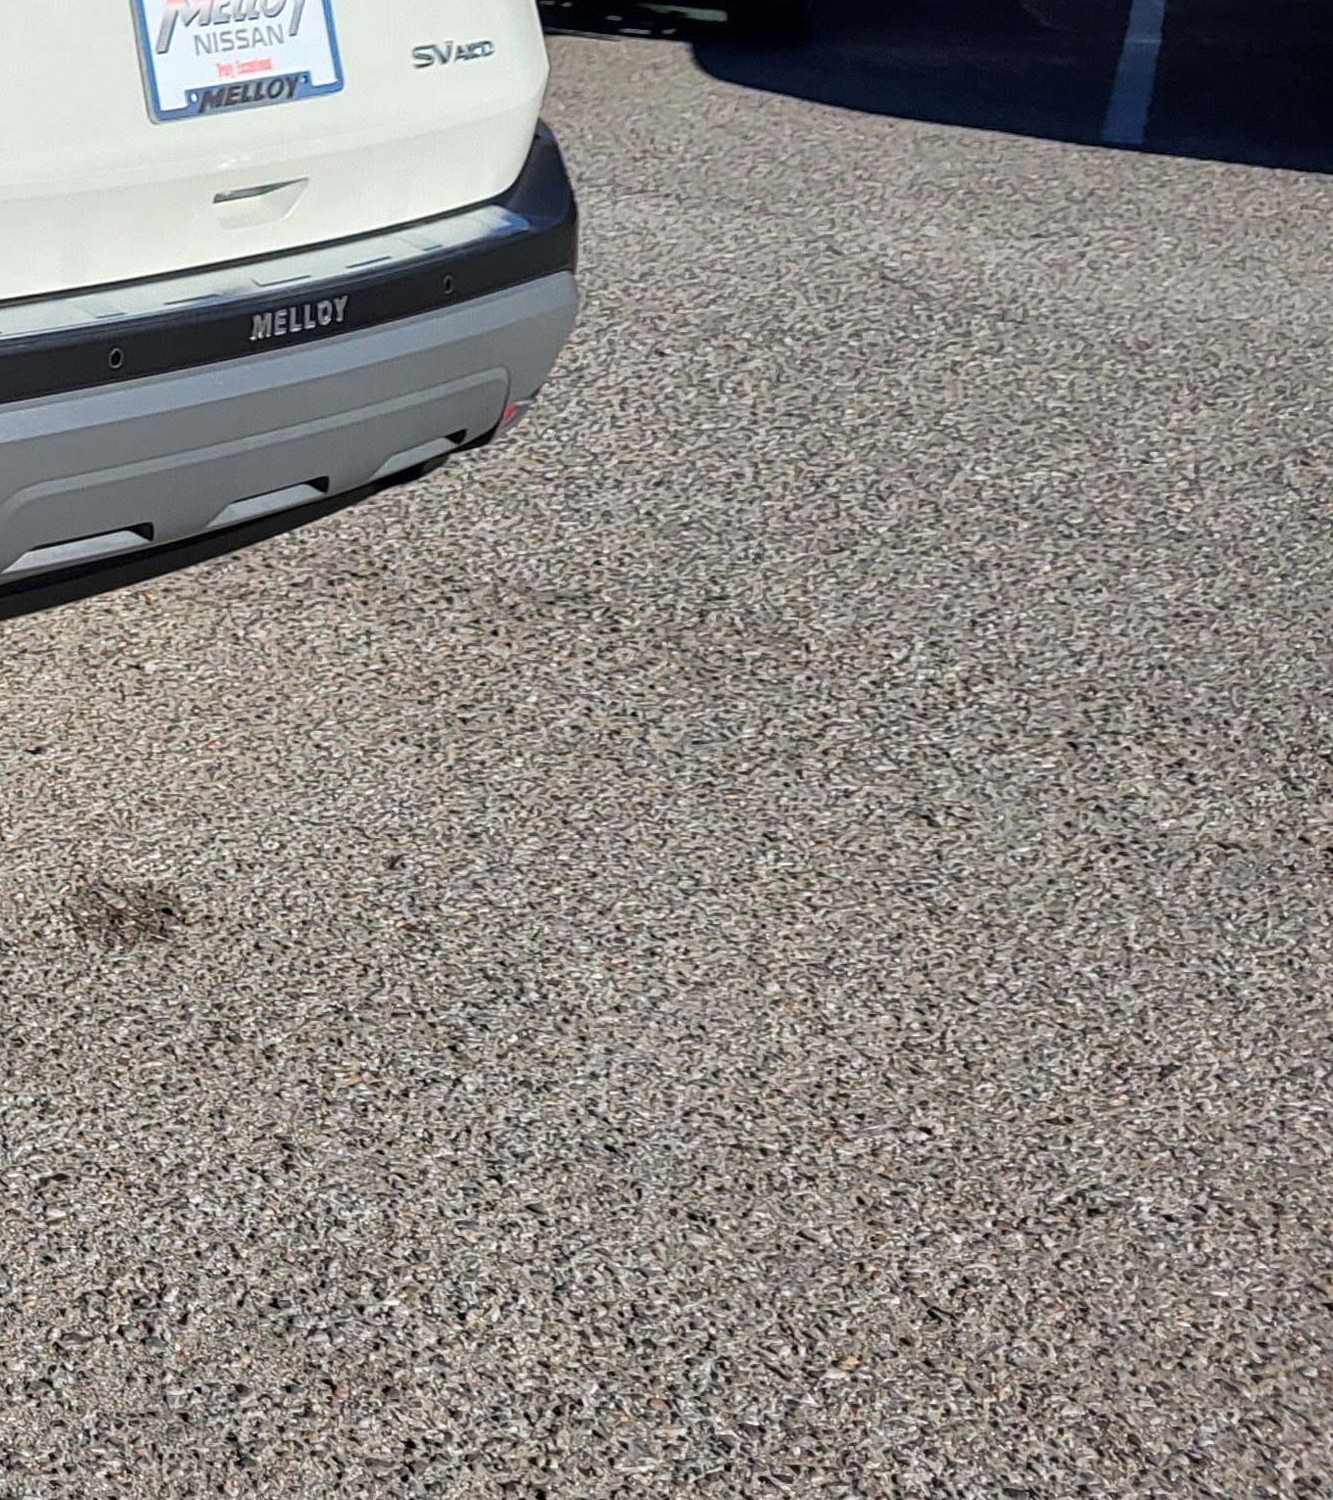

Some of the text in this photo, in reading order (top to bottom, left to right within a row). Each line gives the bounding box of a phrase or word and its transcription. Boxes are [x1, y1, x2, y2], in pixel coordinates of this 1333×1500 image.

[194, 24, 284, 56] NISSAN
[412, 40, 453, 69] SV
[199, 75, 298, 114] MELLOY
[249, 295, 349, 341] MELLOY
